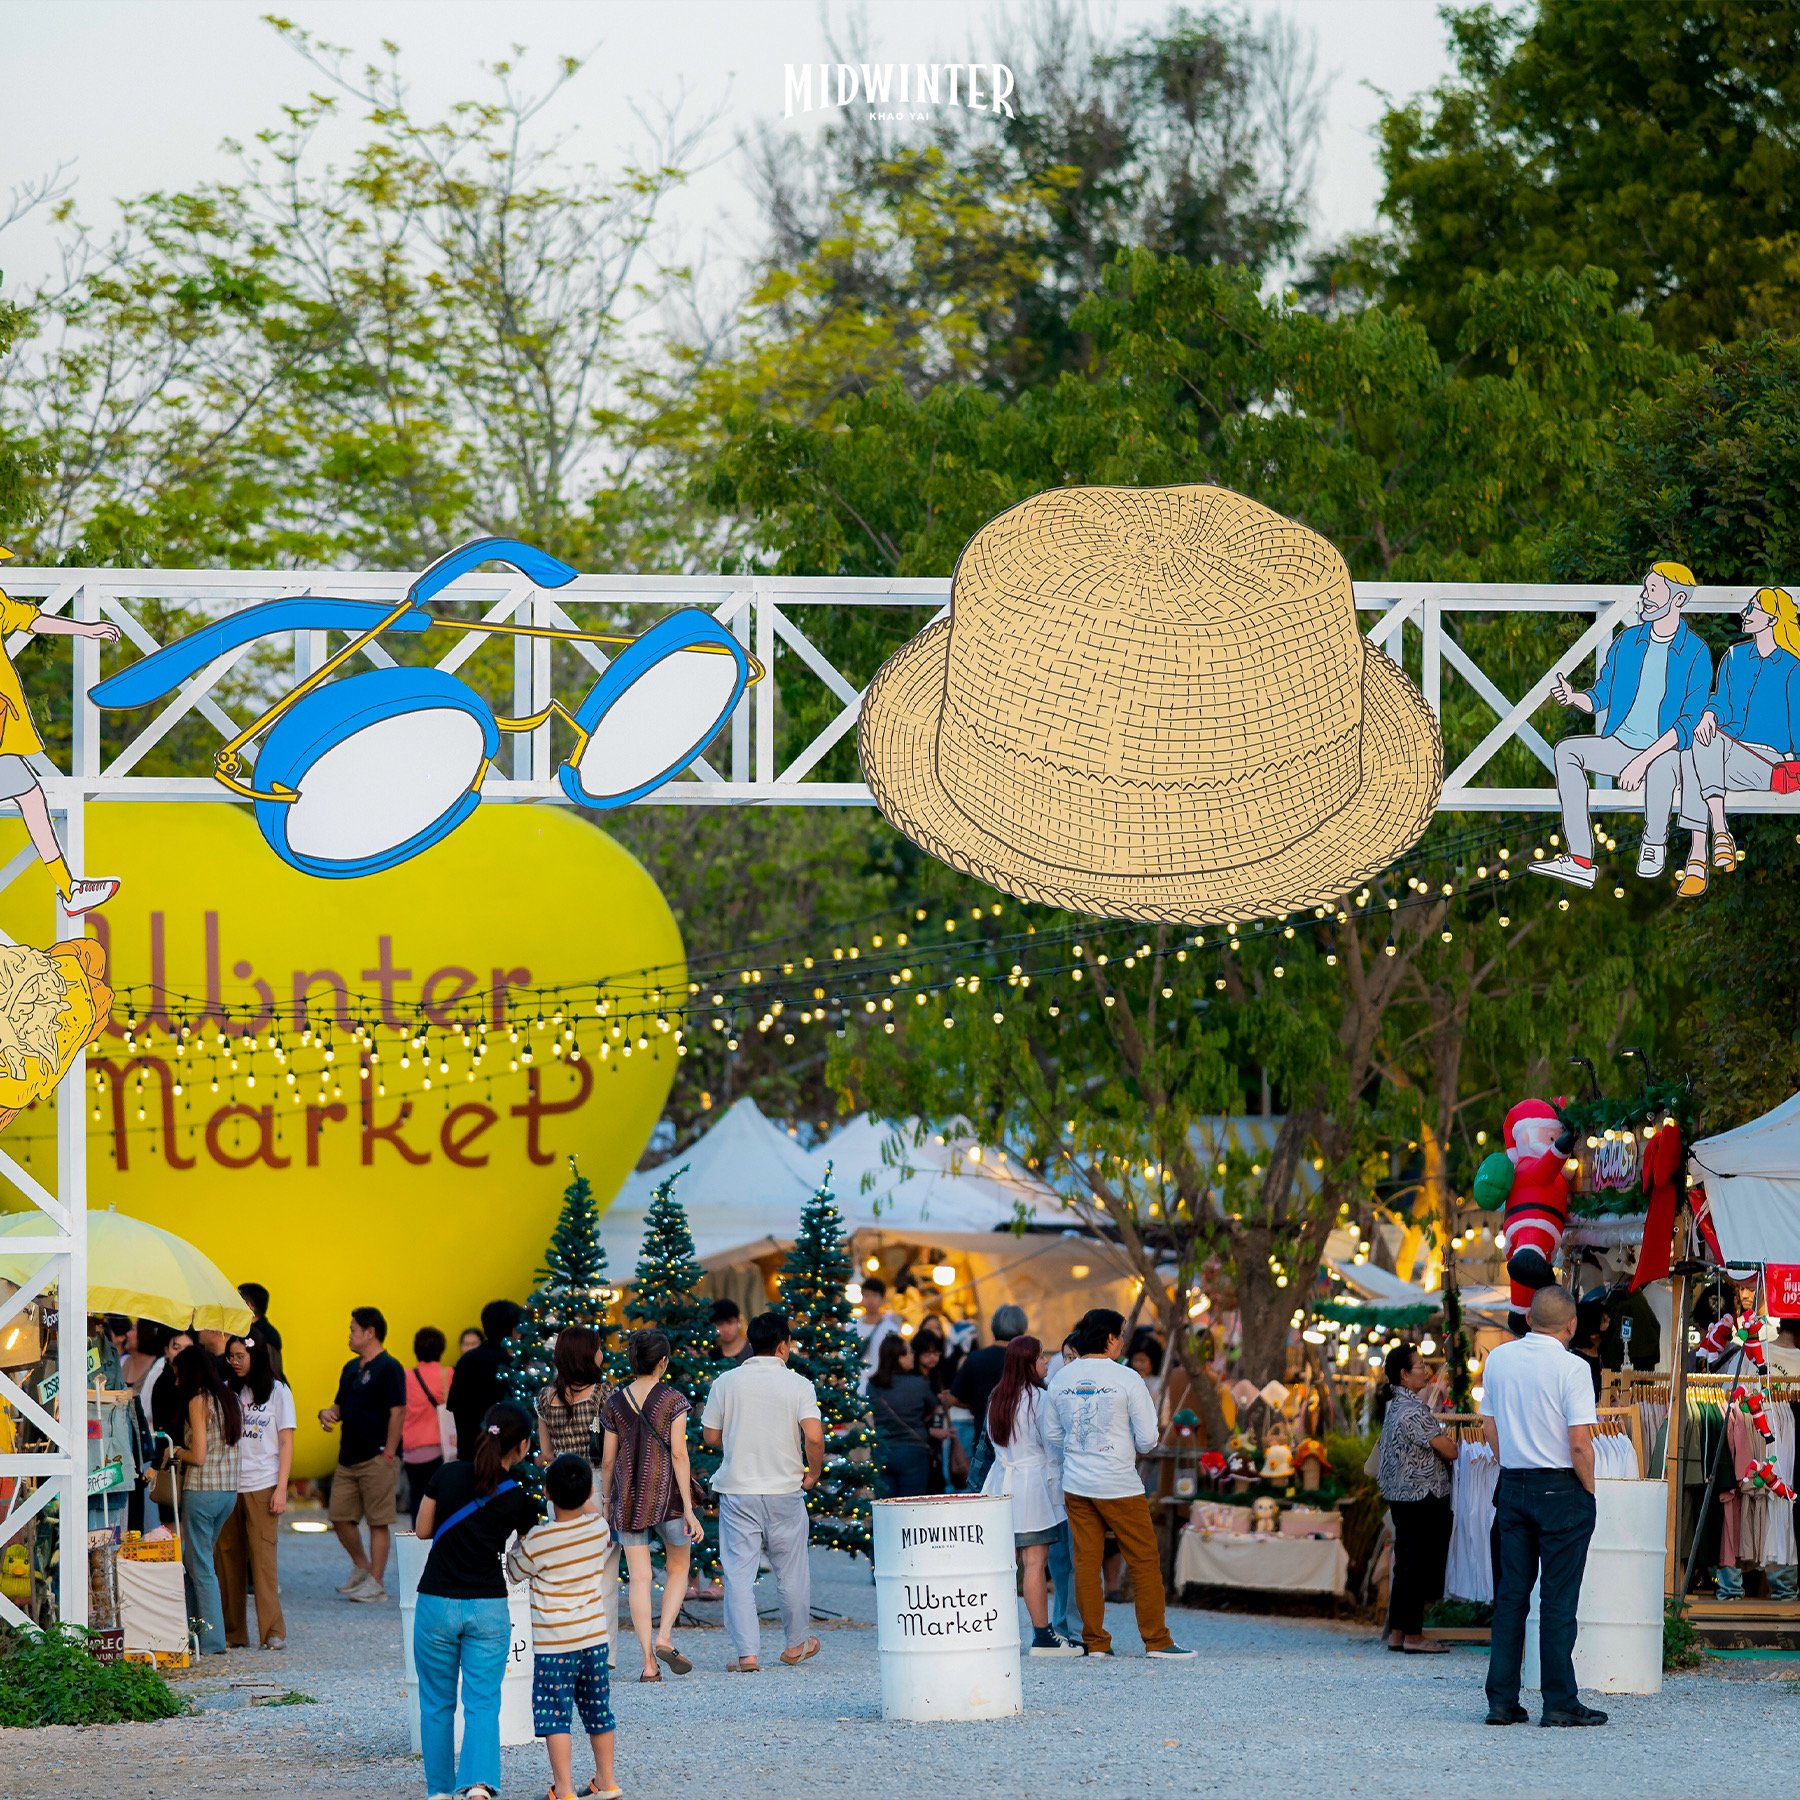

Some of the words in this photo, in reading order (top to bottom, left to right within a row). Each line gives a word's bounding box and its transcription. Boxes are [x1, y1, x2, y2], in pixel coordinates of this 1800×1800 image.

[85, 910, 533, 1039] Winter
[85, 1051, 595, 1172] Market
[901, 1524, 984, 1550] MIDWINTER
[904, 1584, 988, 1610] Winter
[897, 1608, 998, 1636] Market
